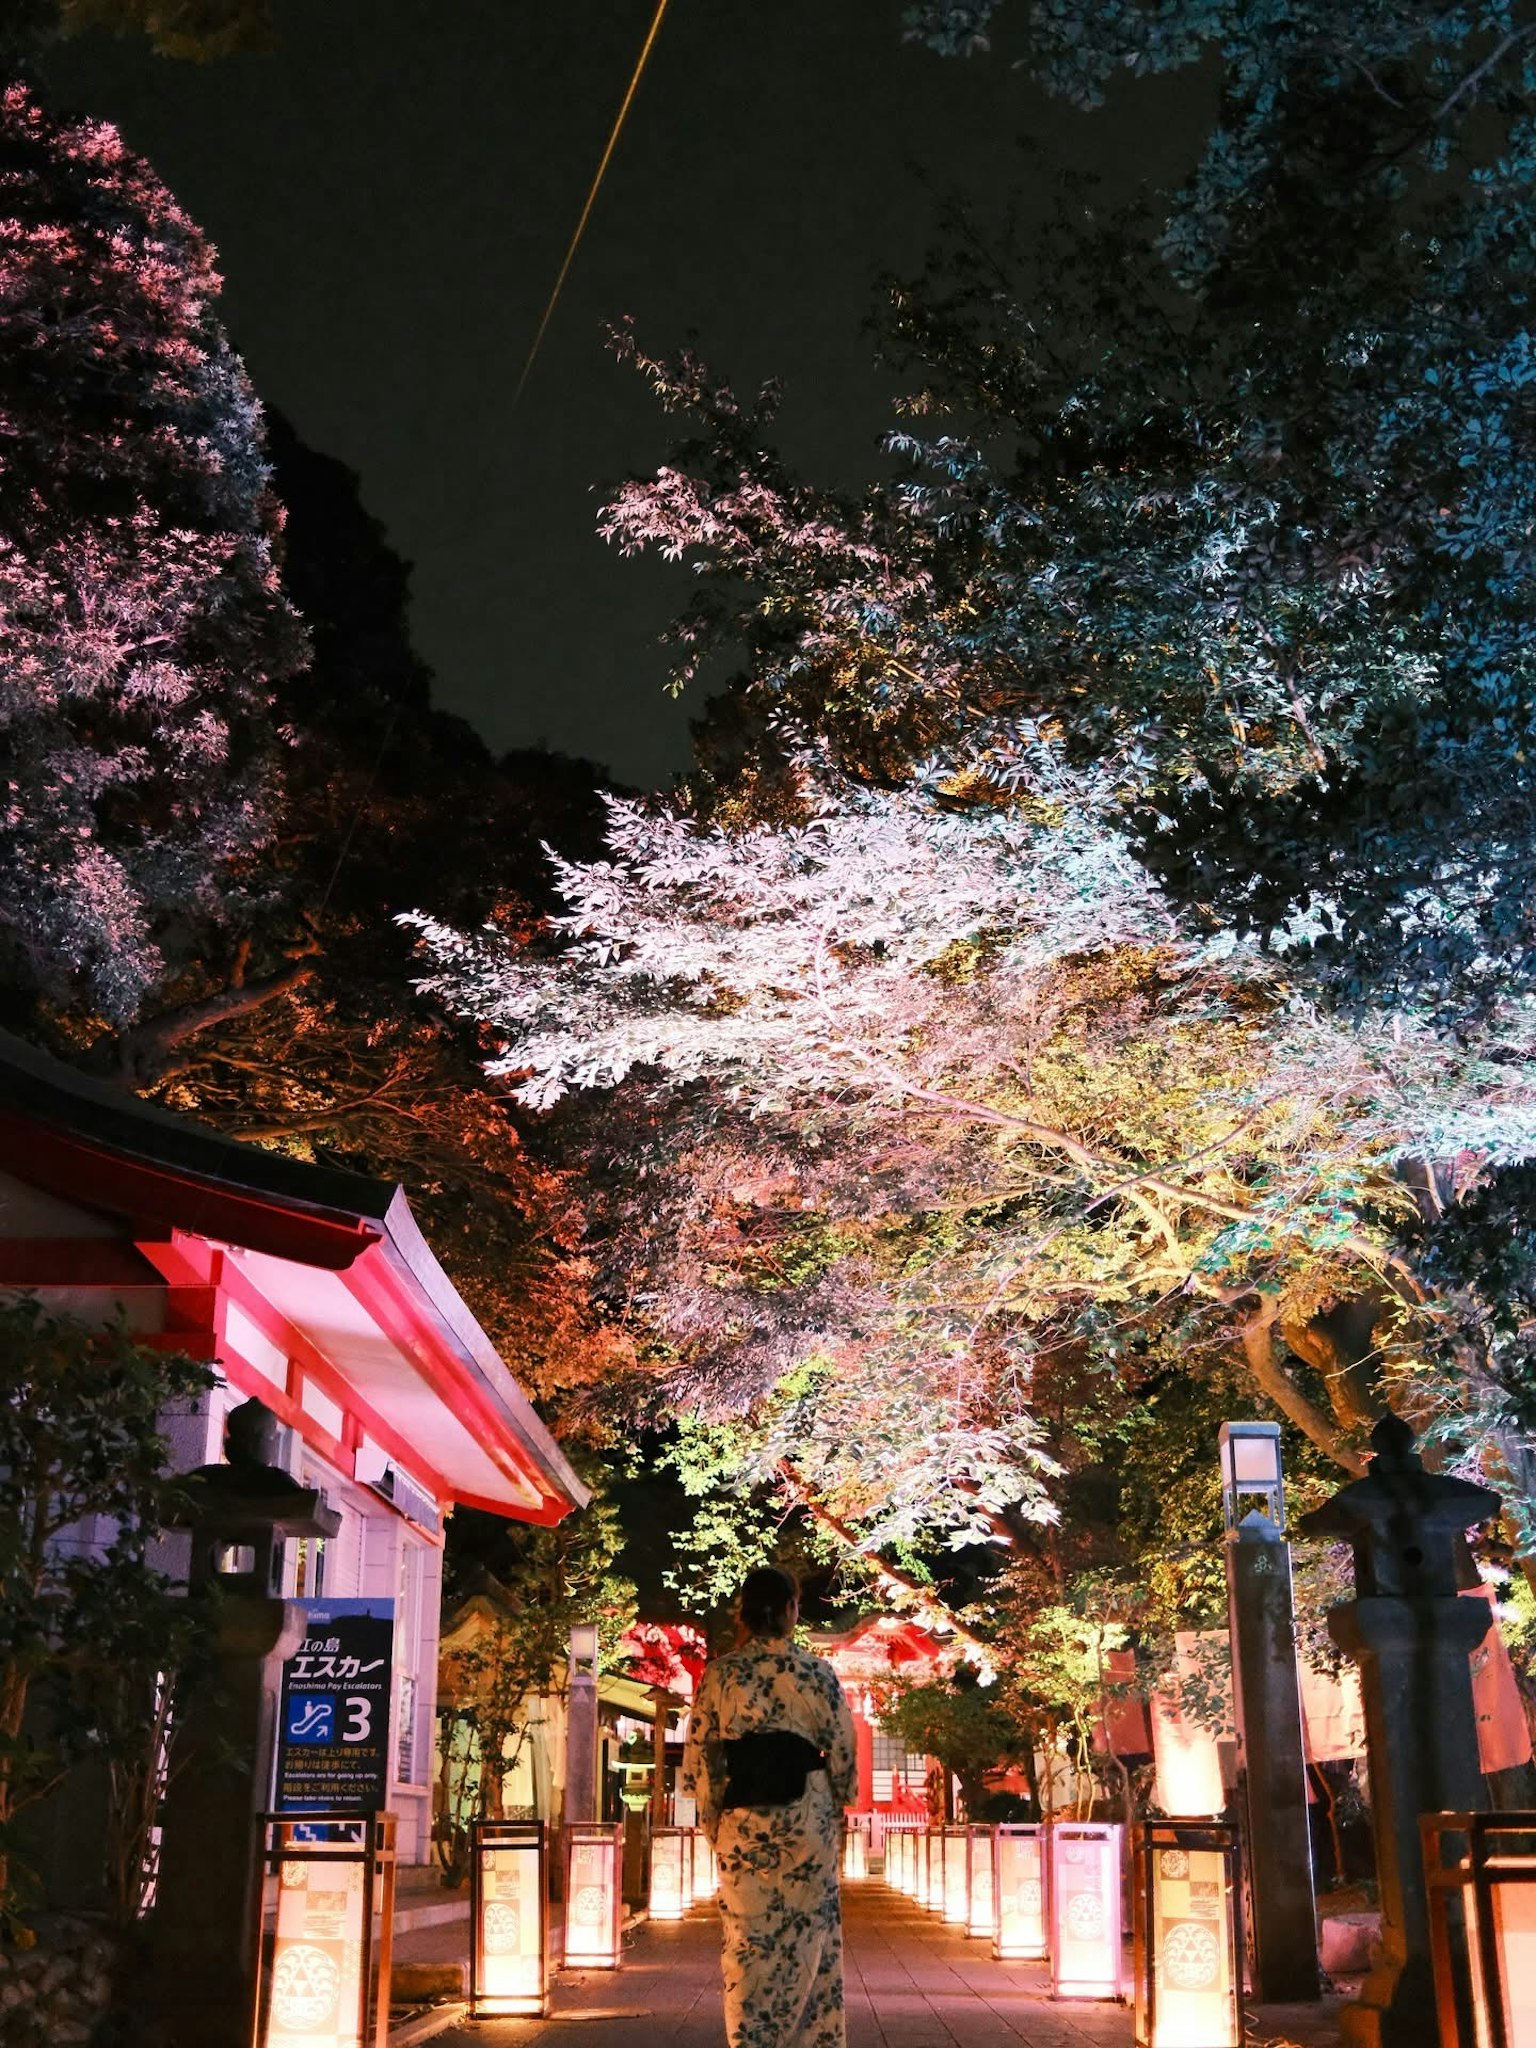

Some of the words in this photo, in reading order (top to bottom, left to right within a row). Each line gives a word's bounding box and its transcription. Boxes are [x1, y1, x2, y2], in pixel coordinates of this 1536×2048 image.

[289, 1655, 384, 1678] エスカー
[288, 1682, 326, 1691] Enoshima
[327, 1682, 342, 1692] Pay
[343, 1682, 382, 1691] Escalators
[342, 1697, 372, 1742] 3
